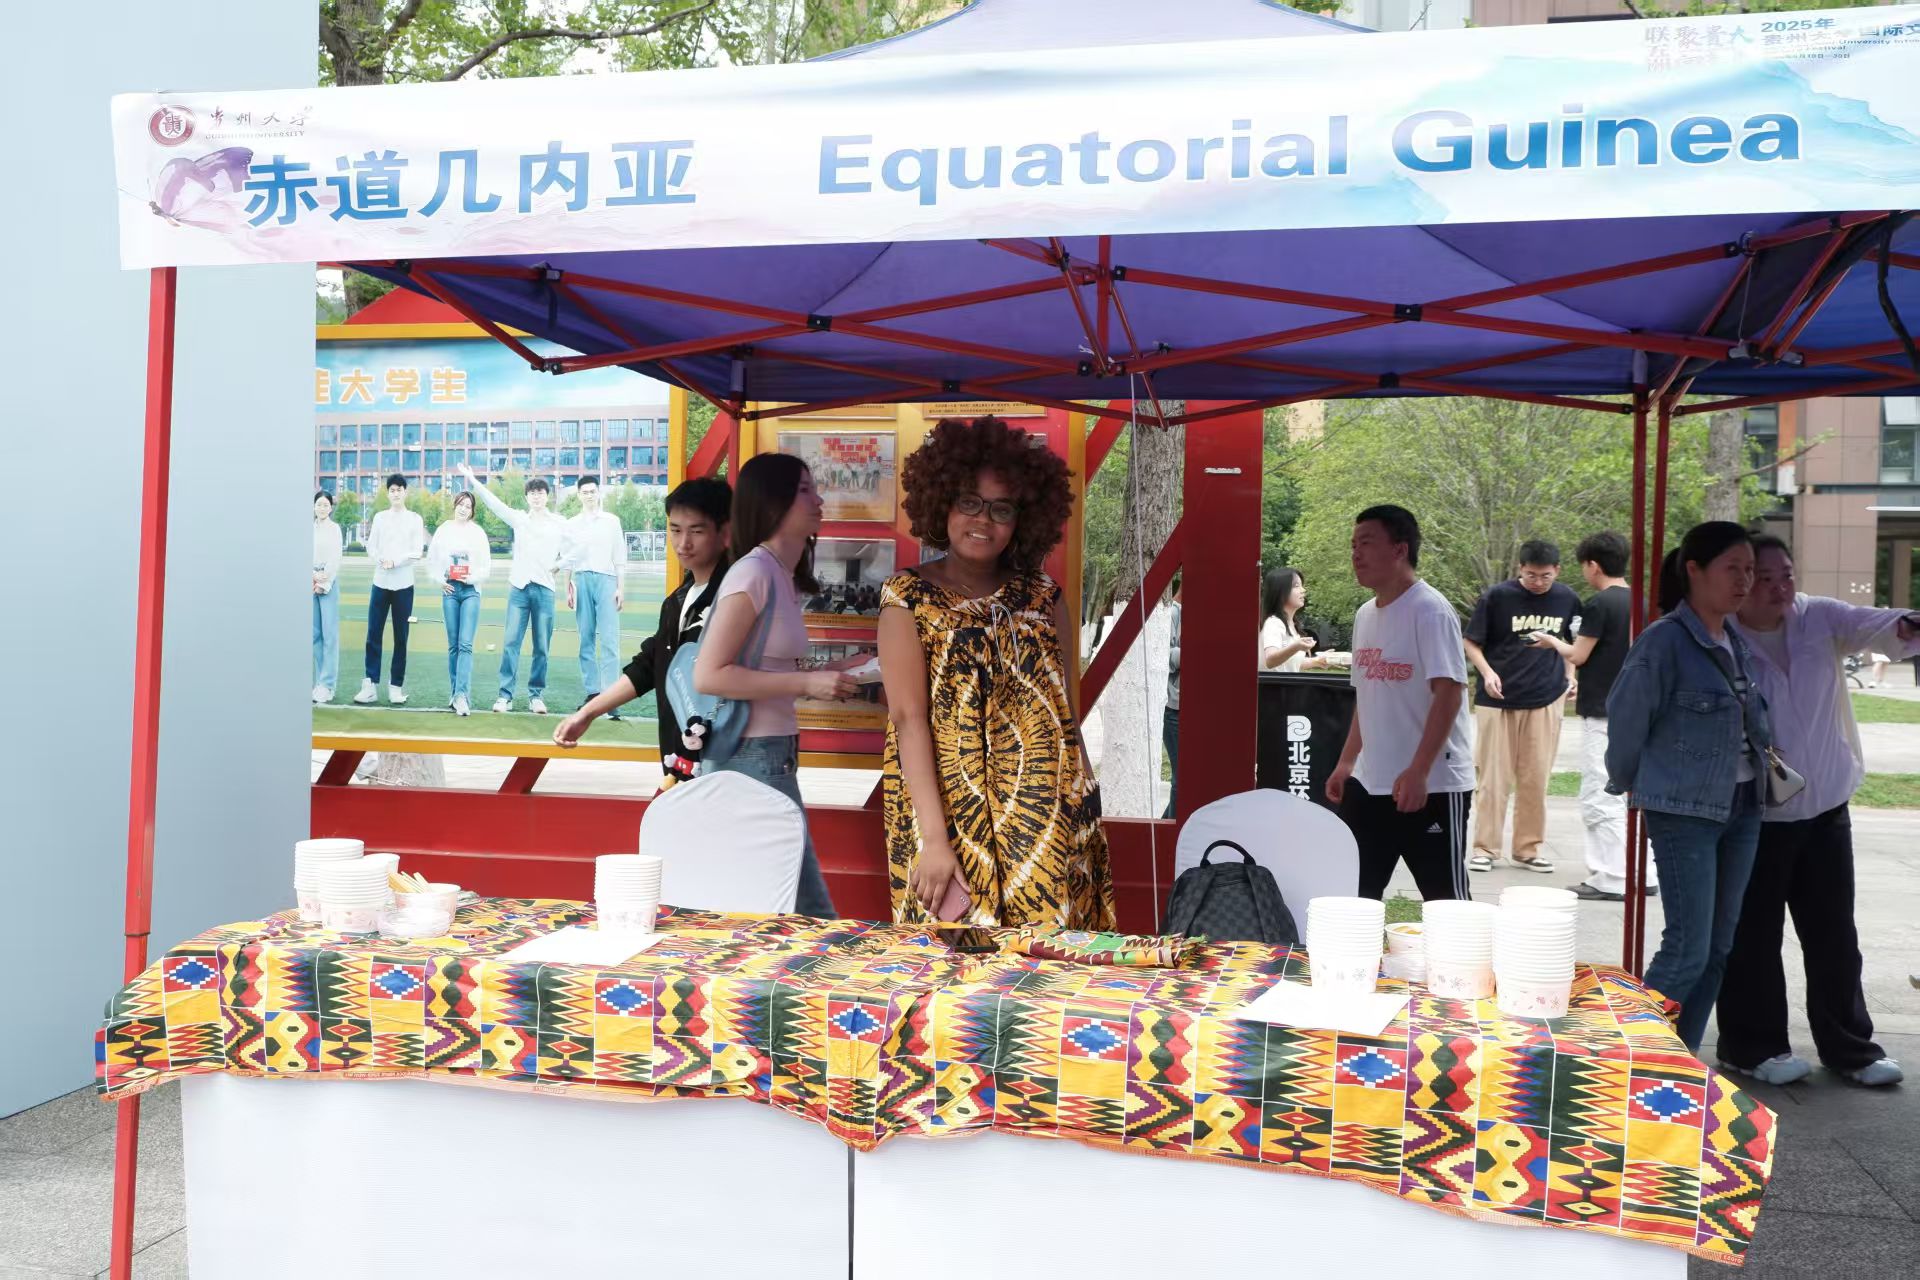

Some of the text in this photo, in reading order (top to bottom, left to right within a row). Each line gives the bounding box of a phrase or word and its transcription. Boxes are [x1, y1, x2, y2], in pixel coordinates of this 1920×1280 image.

[1761, 18, 1835, 33] 2025年
[244, 139, 697, 228] 赤道几内亚
[818, 103, 1800, 206] Equatorial Guinea
